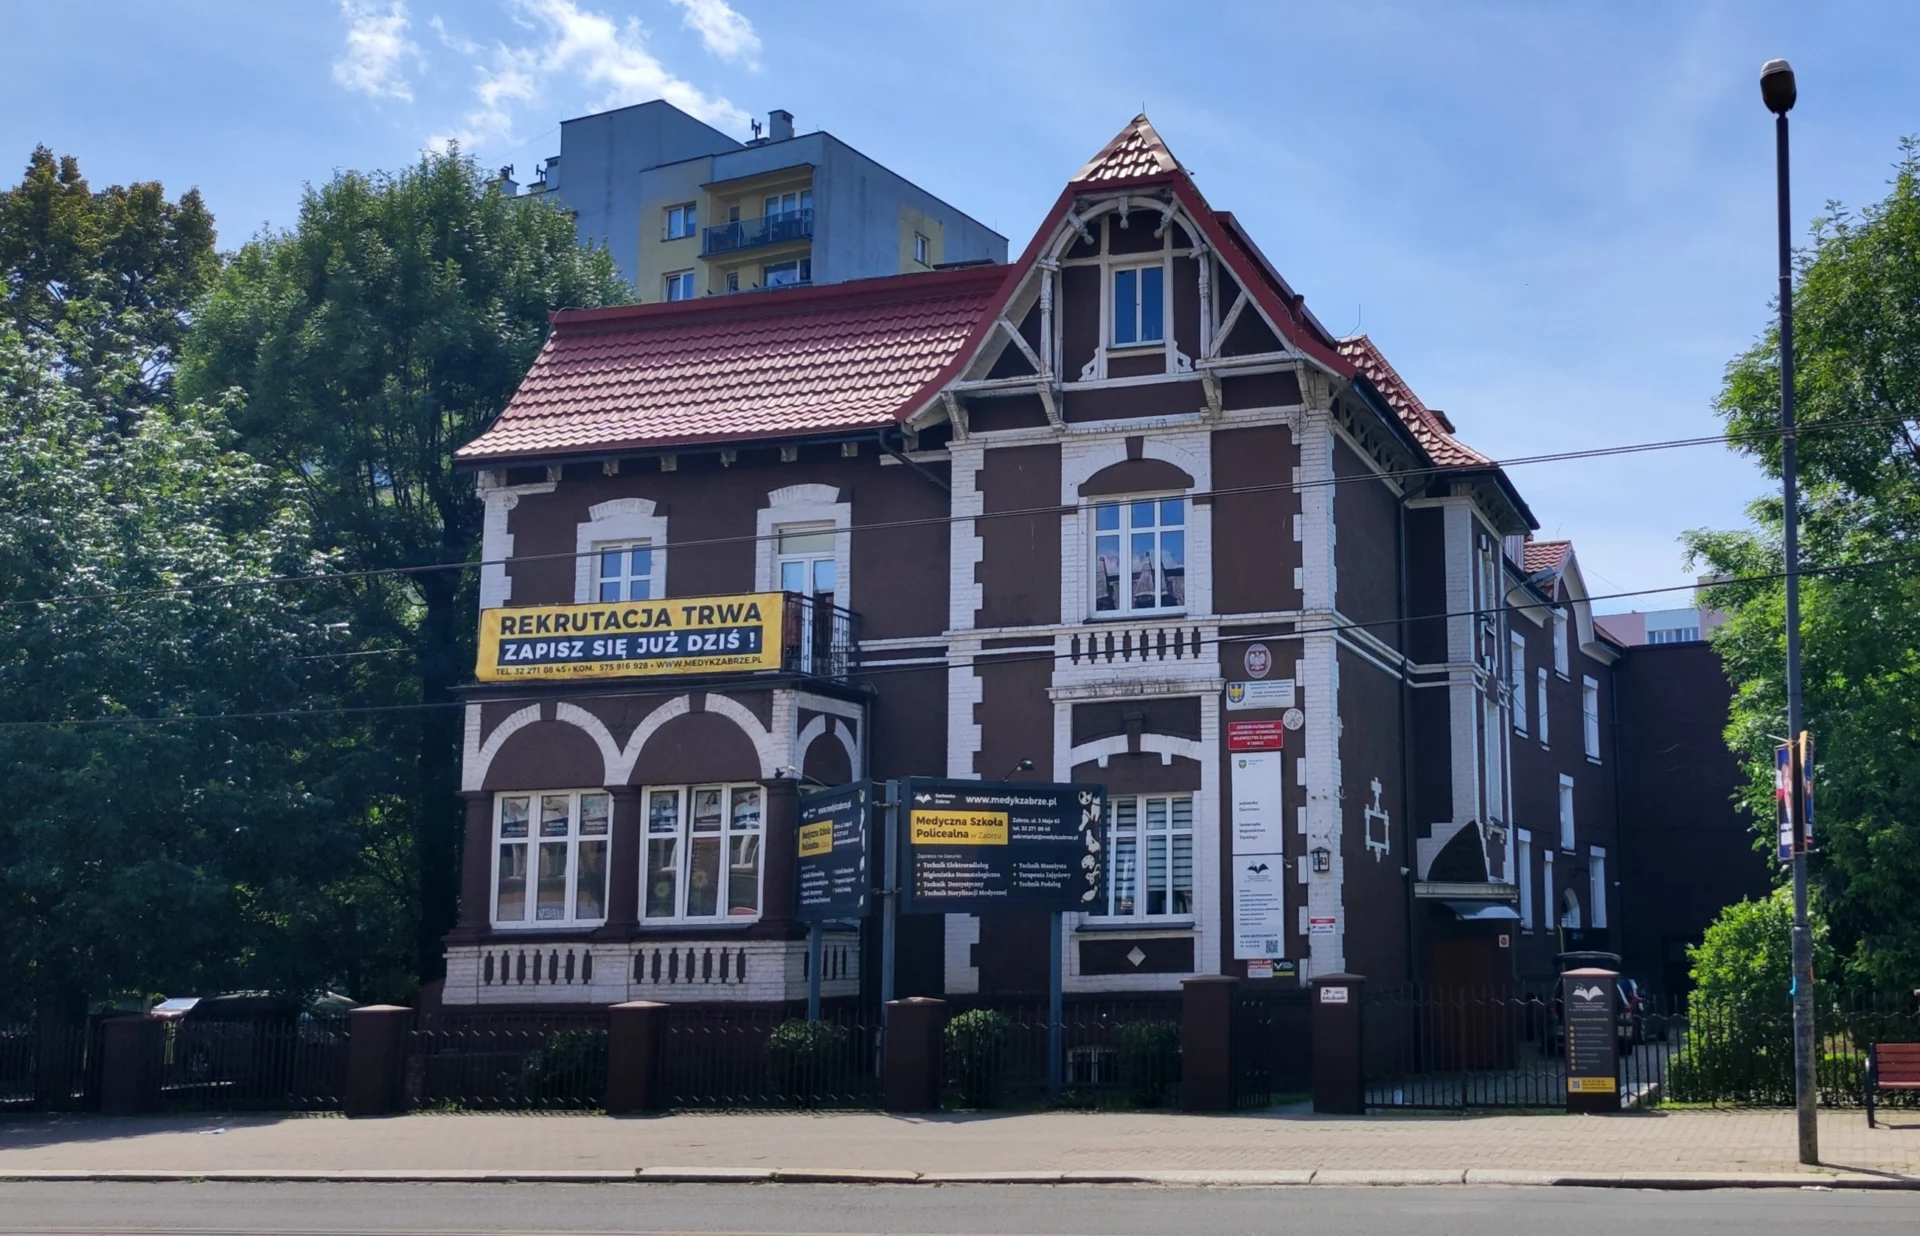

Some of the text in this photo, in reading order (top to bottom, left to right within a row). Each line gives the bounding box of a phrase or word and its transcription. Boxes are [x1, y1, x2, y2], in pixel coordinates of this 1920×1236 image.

[500, 602, 762, 636] REKRUTACJA TRWA
[504, 628, 755, 660] ZAPISZ SIĘ JUŻ DZIŚ !
[527, 667, 540, 675] 271
[556, 665, 567, 673] 45
[573, 664, 594, 672] KOM.
[634, 661, 648, 669] 928
[656, 656, 762, 669] WWW.MEDYKZABRZE.PL
[965, 796, 1057, 807] www.medykzabrze.pl
[916, 816, 1004, 827] Medyczna Szkoła
[916, 828, 969, 838] Policealna
[978, 831, 1002, 839] Zabrzu
[947, 861, 989, 870] Elektroradiolog
[923, 871, 1000, 879] Higienistka Stomatologiczna
[979, 889, 1007, 897] Medycznej
